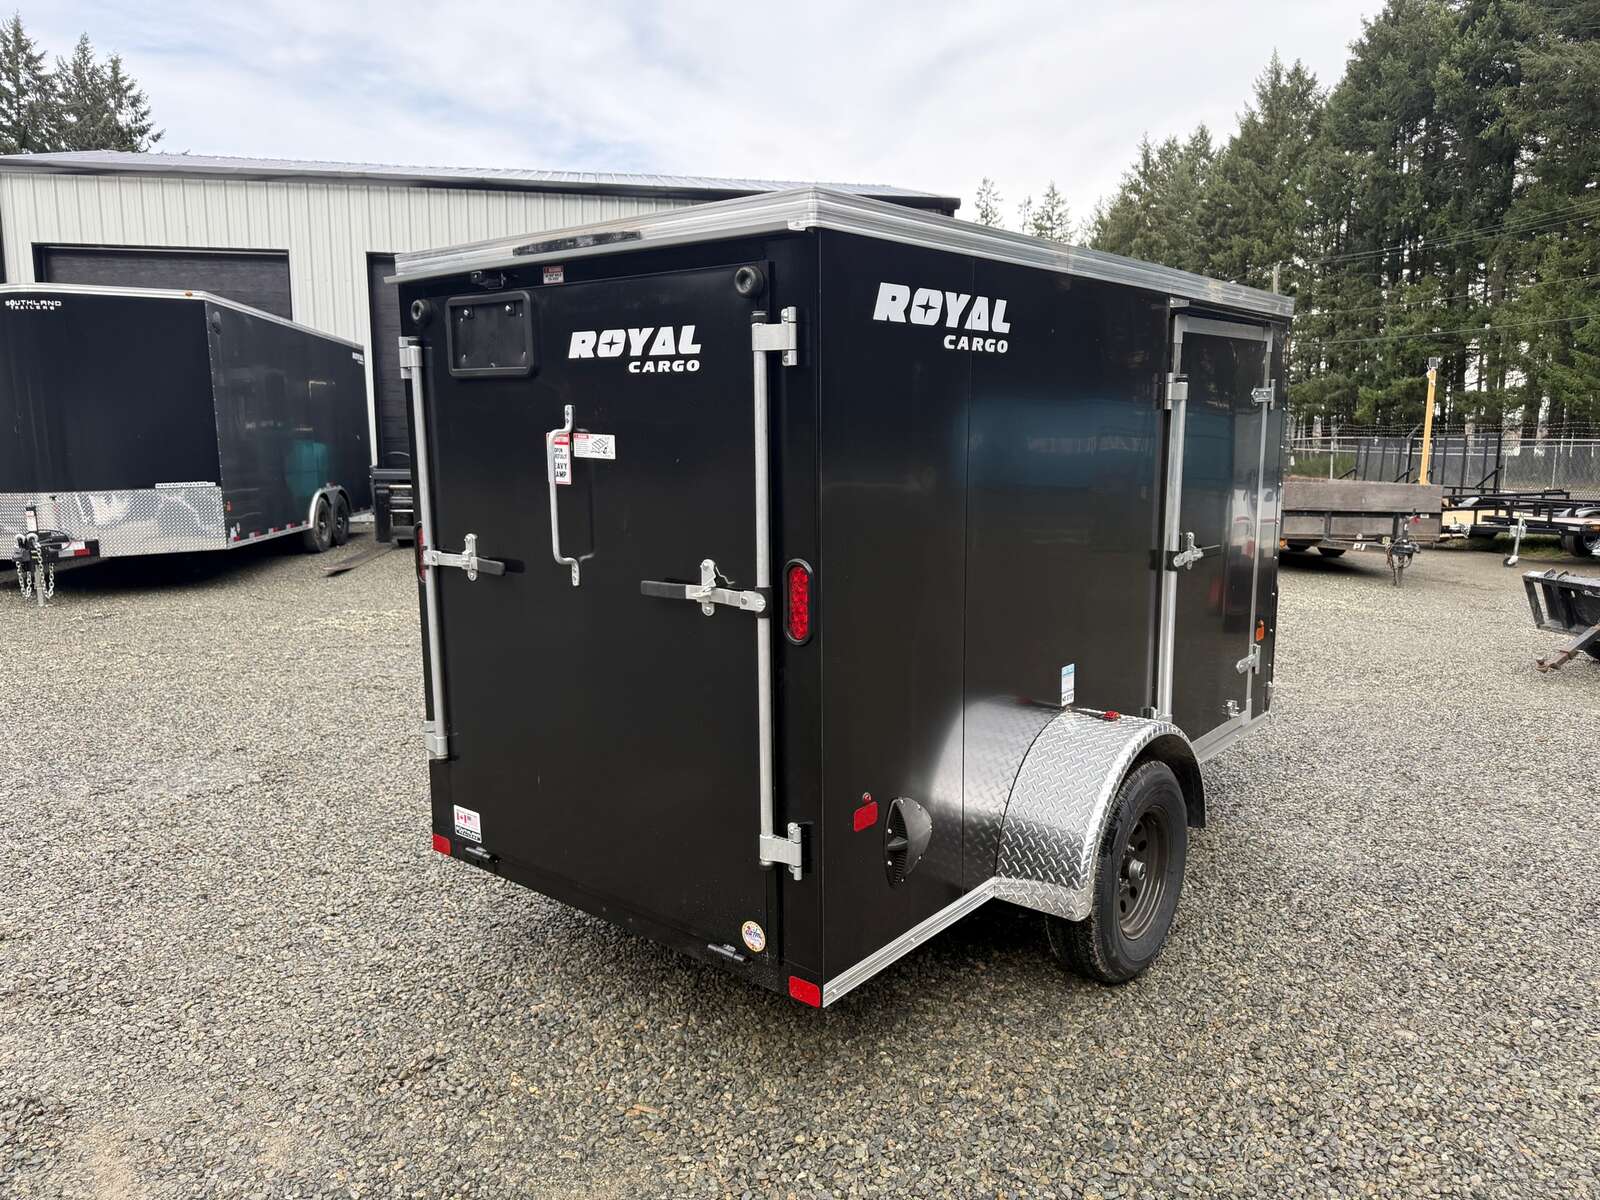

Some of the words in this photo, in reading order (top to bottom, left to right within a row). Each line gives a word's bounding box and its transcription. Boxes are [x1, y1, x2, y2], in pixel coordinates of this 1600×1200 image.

[873, 282, 1011, 334] ROYAL
[568, 325, 701, 359] ROYAL
[943, 334, 1009, 353] CARGO
[628, 360, 701, 373] CARGO
